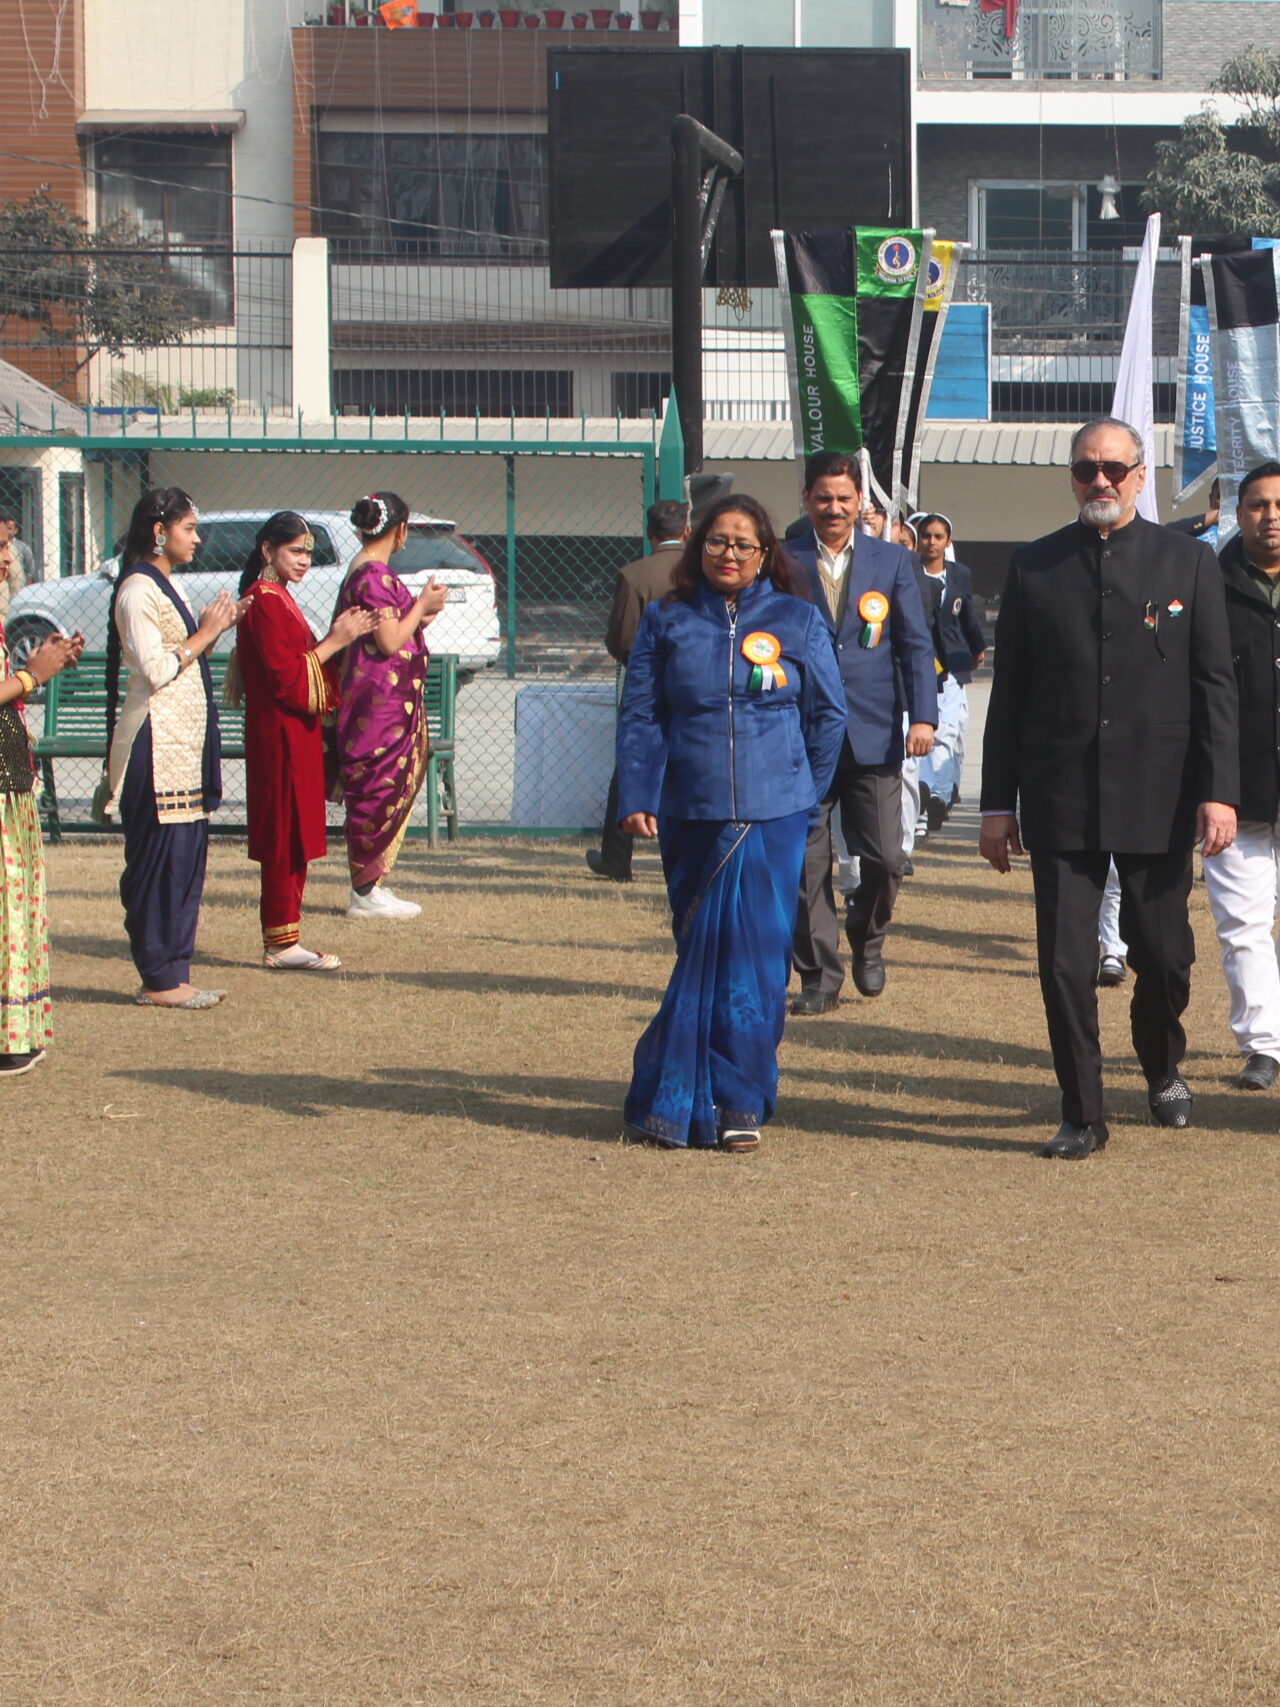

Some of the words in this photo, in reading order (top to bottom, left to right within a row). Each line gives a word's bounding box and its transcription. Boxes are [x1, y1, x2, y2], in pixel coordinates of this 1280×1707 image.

[803, 324, 816, 378] HOUSE
[1194, 334, 1210, 385] HOUSE
[1227, 361, 1240, 409] HOUSE
[807, 385, 824, 453] VALOUR
